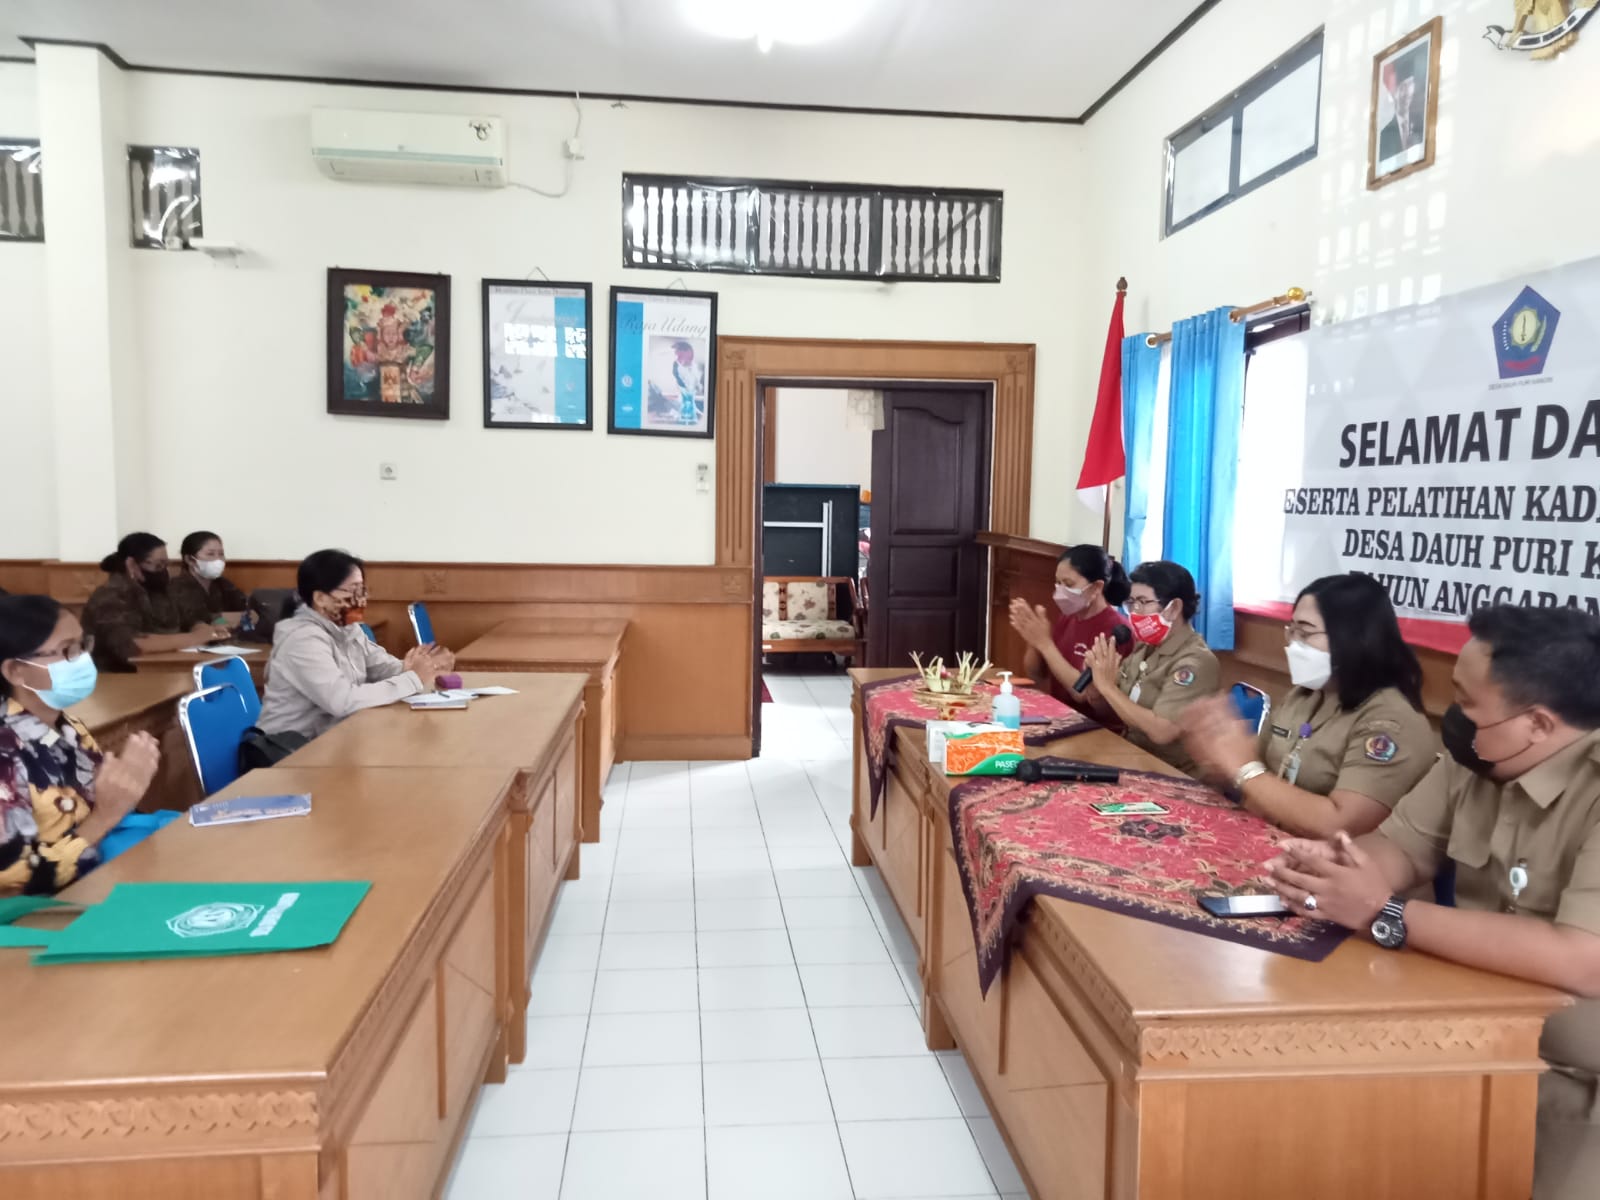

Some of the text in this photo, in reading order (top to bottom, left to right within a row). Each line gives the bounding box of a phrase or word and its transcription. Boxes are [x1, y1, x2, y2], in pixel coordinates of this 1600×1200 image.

[1339, 399, 1600, 468] SELAMAT DA
[1284, 485, 1600, 523] ESERTA PELATIHAN KAD
[1342, 528, 1405, 562] DESA
[1409, 531, 1484, 569] DAUH
[1490, 535, 1574, 577] PURI
[1350, 570, 1430, 610] HUN
